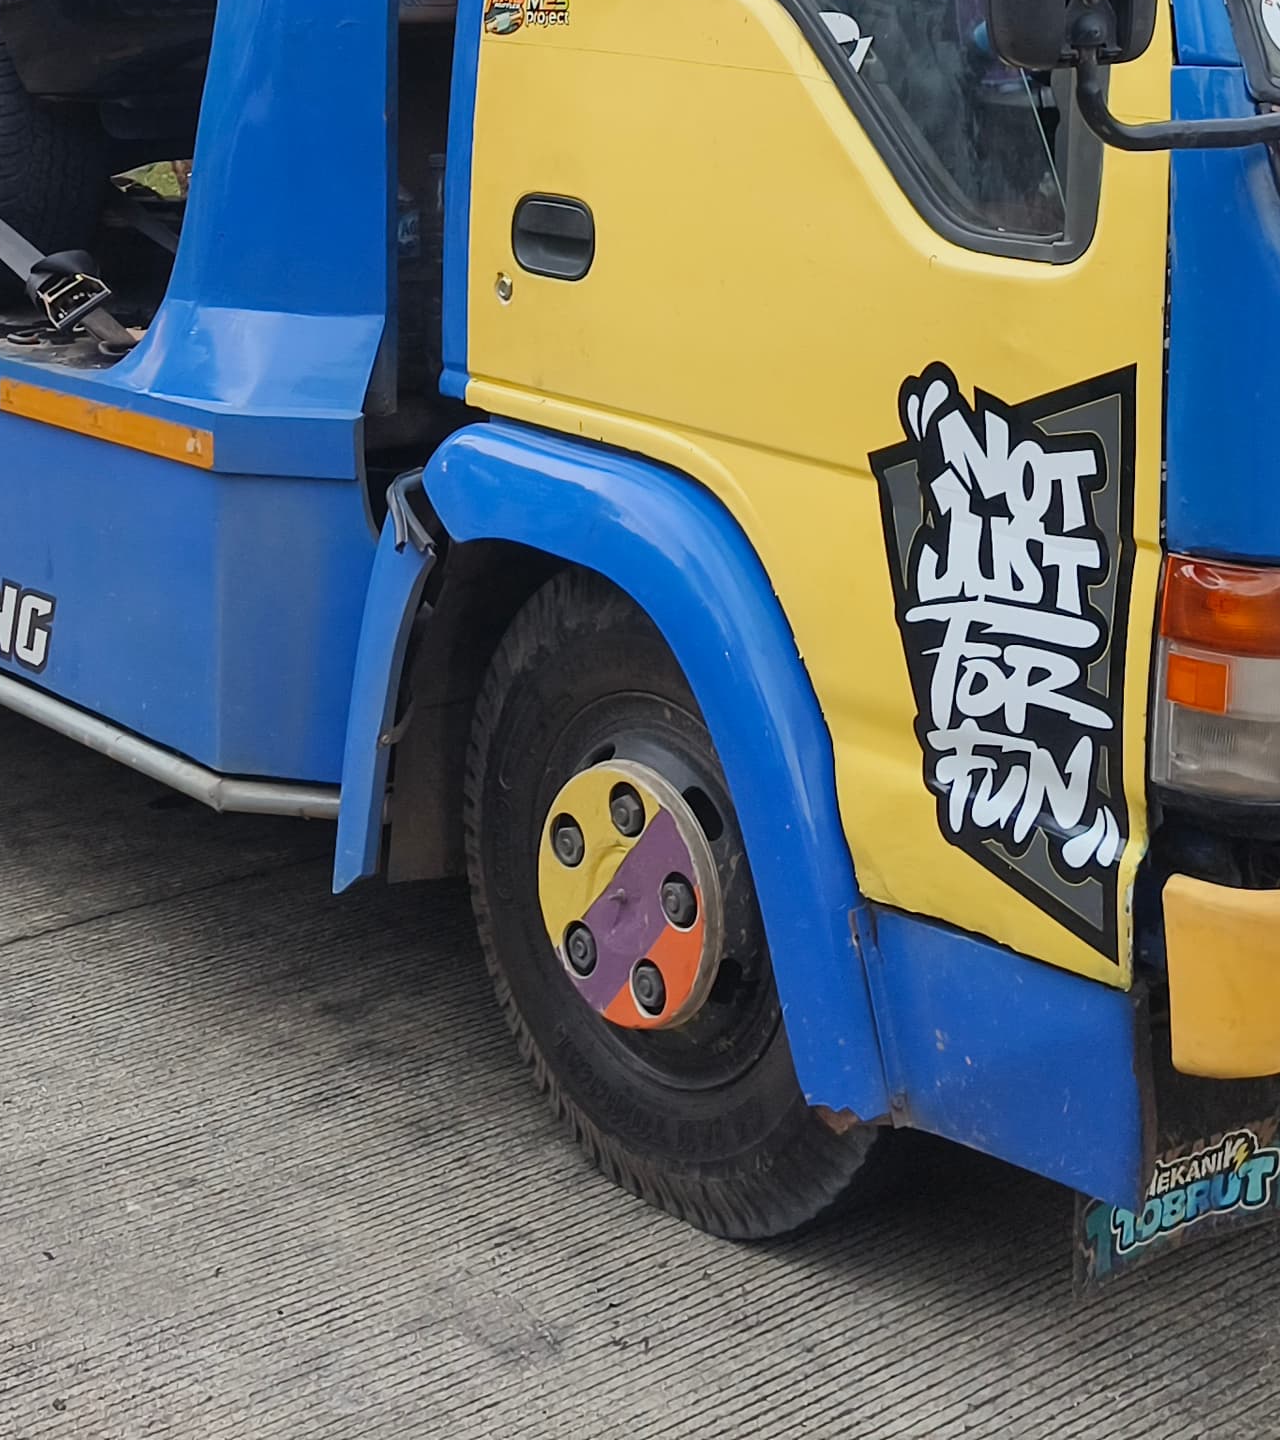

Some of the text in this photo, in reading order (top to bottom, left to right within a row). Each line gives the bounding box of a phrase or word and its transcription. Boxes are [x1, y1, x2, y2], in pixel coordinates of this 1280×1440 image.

[526, 10, 570, 28] project
[917, 467, 1101, 617] JUST
[905, 599, 1114, 733] FOR
